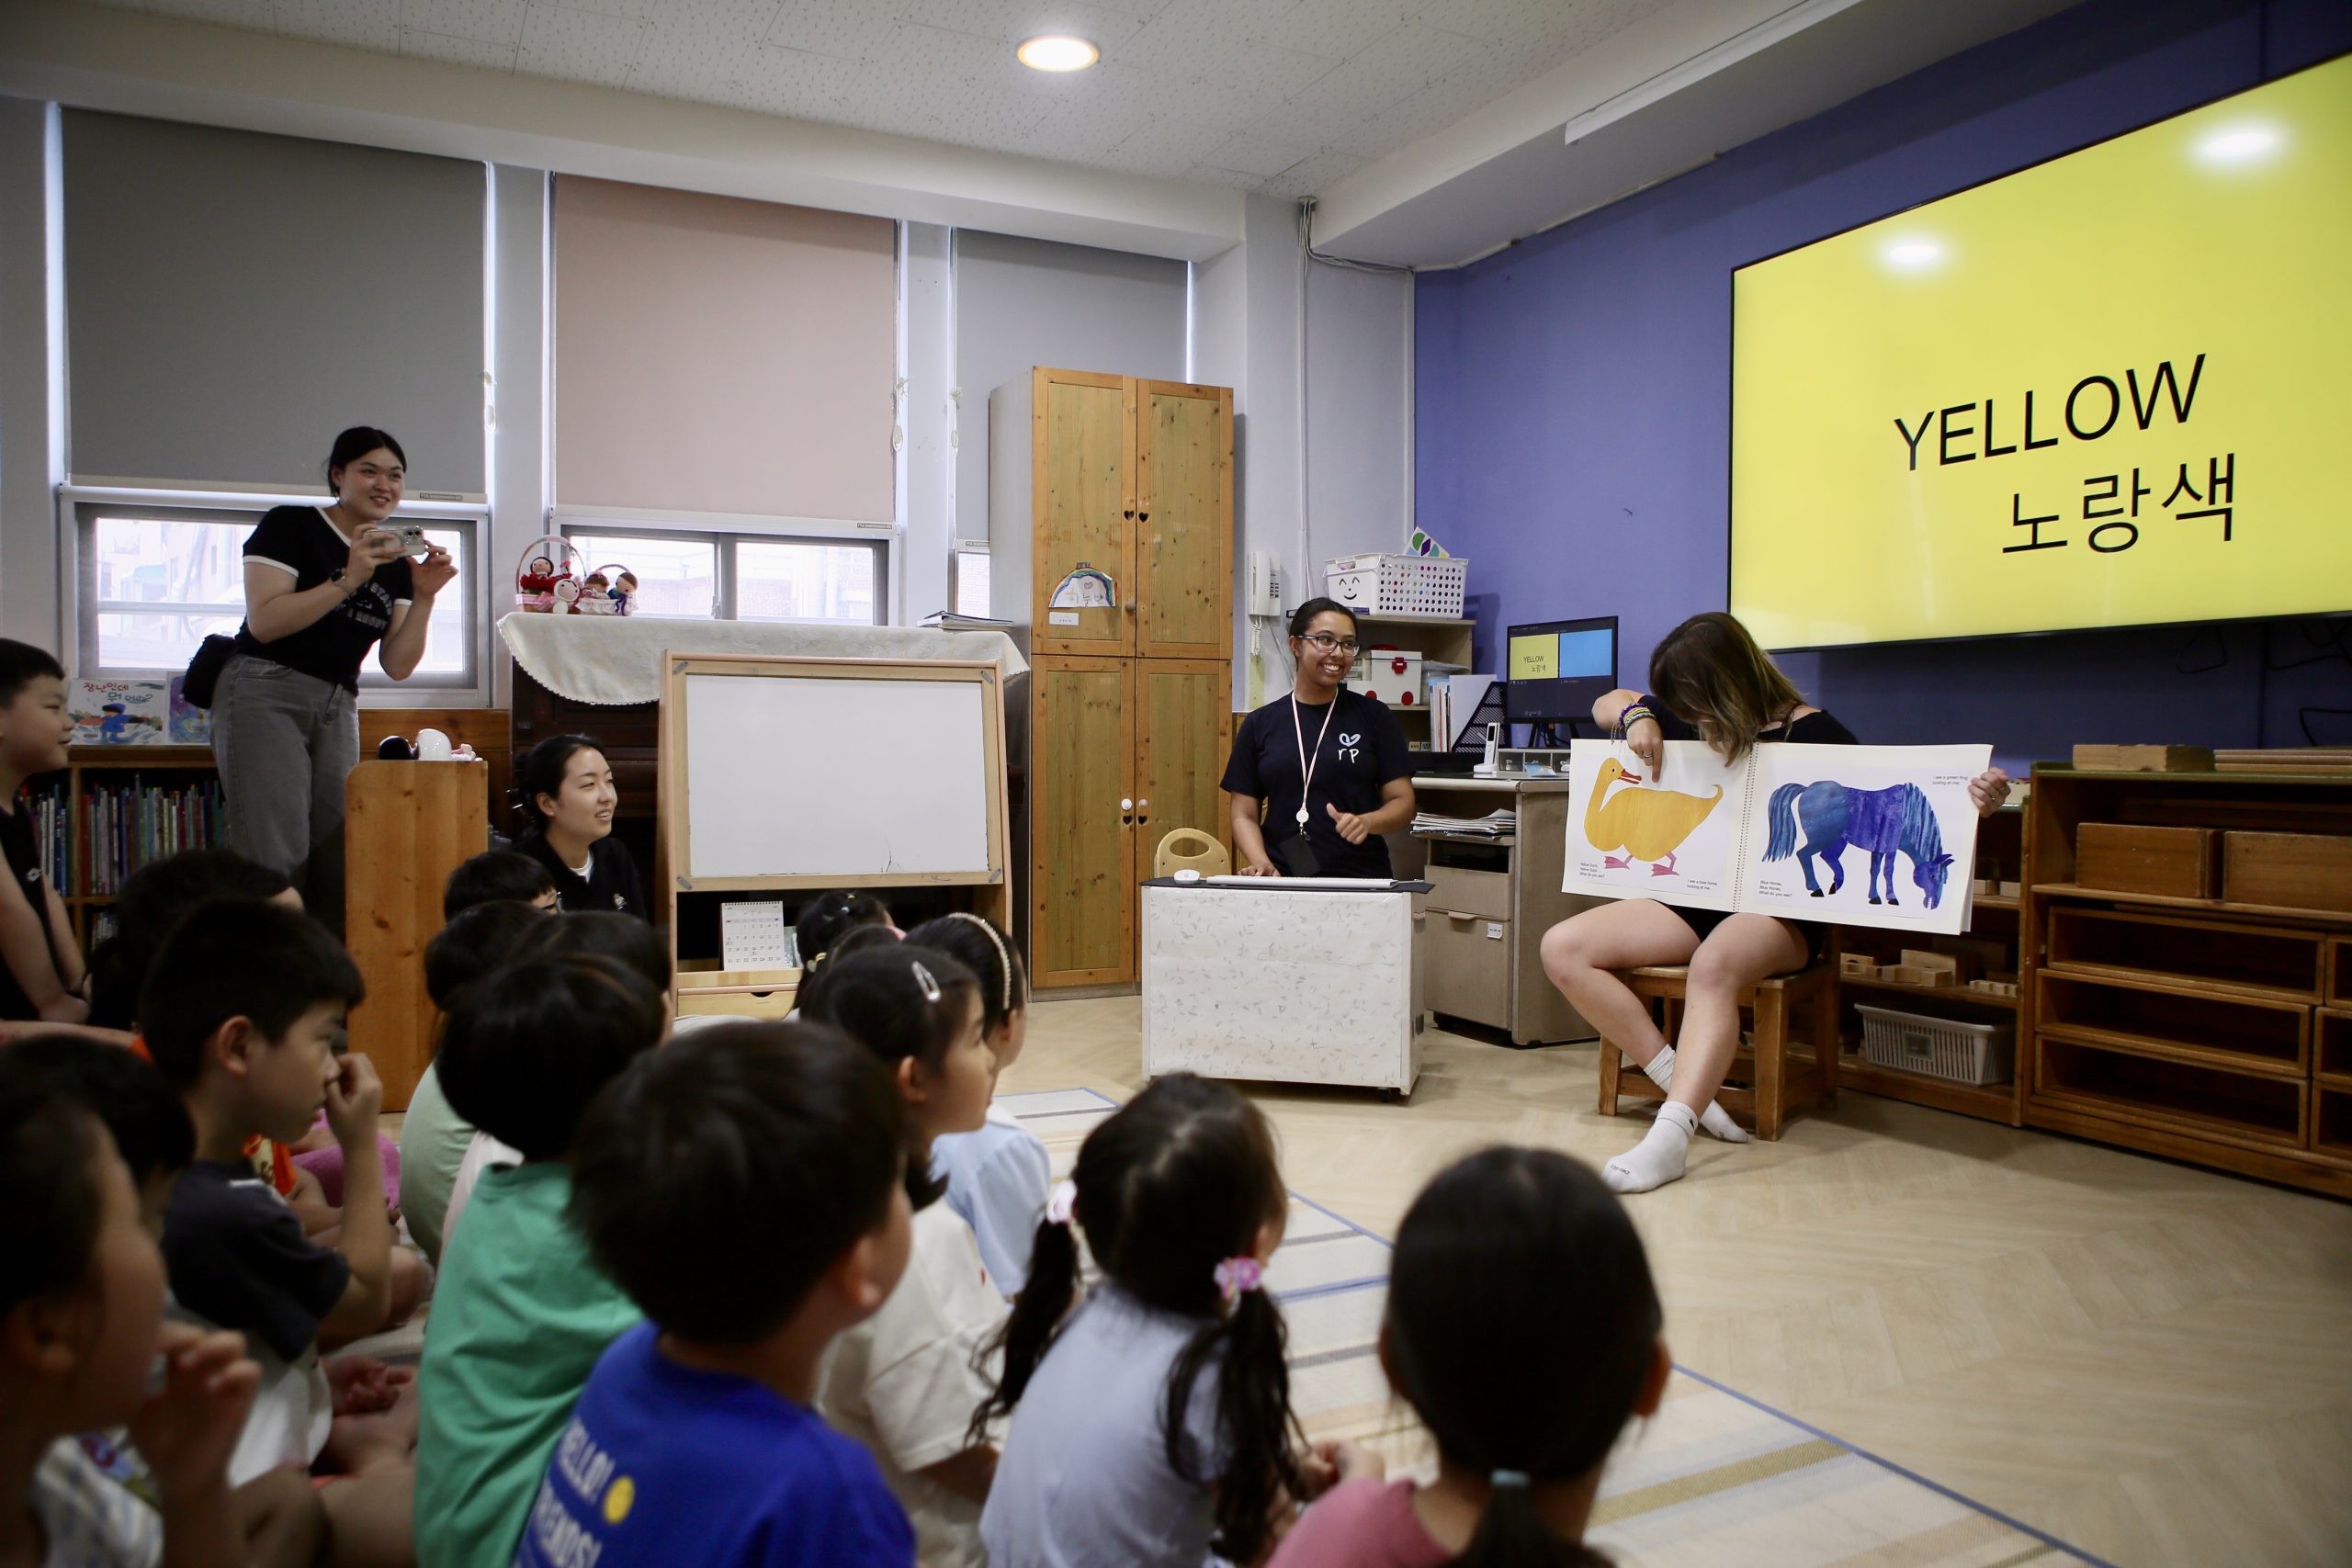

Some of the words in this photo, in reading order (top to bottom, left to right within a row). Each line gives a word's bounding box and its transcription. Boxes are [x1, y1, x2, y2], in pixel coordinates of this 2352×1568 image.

[1894, 354, 2207, 471] YELLOW
[2002, 453, 2235, 554] 노랑색
[84, 682, 129, 693] 장난인데
[559, 1416, 616, 1506] ELLO!
